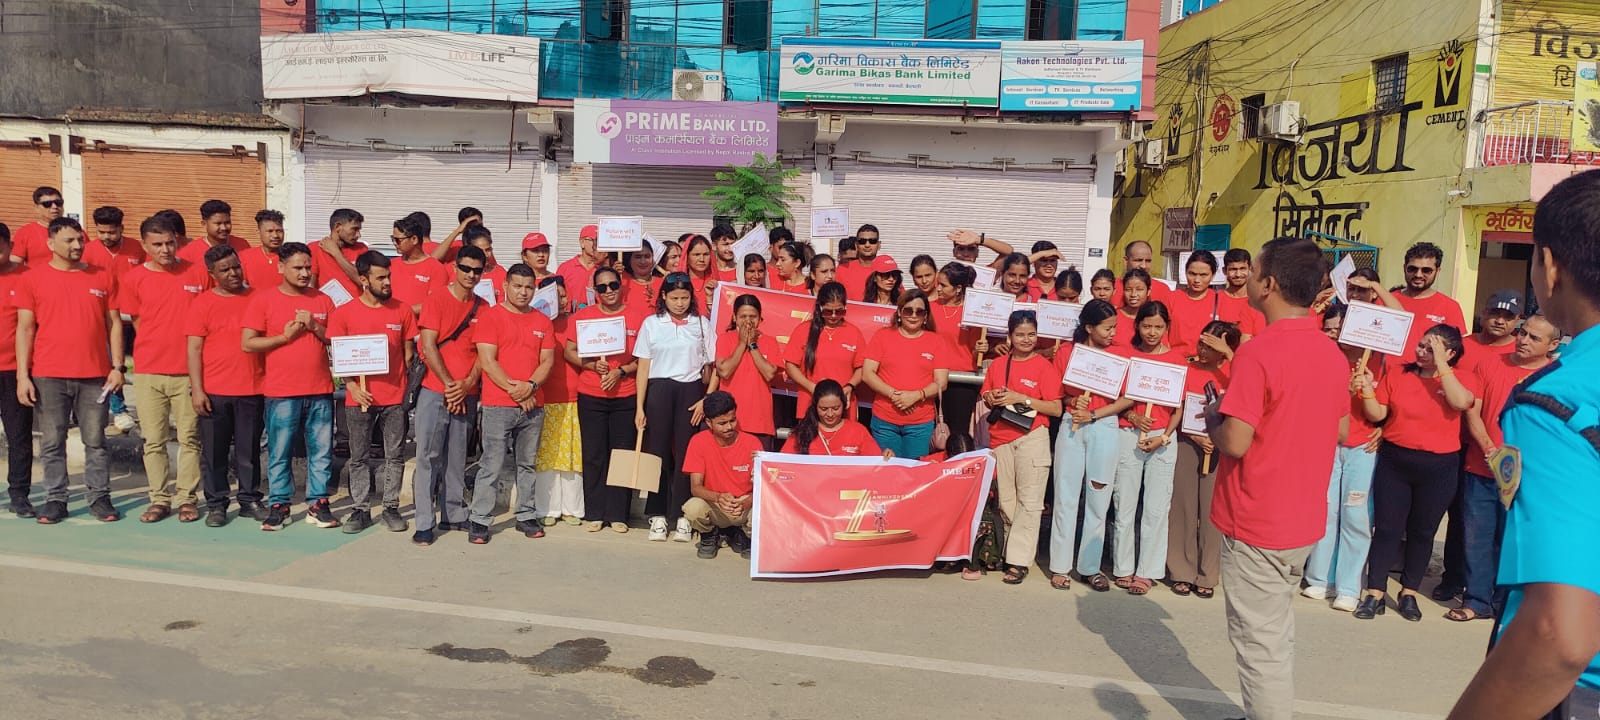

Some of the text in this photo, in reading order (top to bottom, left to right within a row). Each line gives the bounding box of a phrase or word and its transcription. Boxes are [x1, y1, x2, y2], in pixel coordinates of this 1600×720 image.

[817, 54, 851, 67] गरिमा
[857, 54, 896, 68] विकास
[926, 55, 970, 69] लिमिटेड
[1043, 57, 1093, 67] Technologies
[1095, 57, 1110, 65] Pvt.
[1112, 57, 1127, 65] Ltd.
[815, 67, 971, 80] Garima Bikas Bank Limited
[1425, 110, 1465, 126] CEMENT
[693, 119, 735, 132] BANK
[740, 119, 770, 133] LTD.
[731, 134, 769, 147] लिमिटेड
[1251, 100, 1424, 190] विजया
[1168, 230, 1190, 247] ATM
